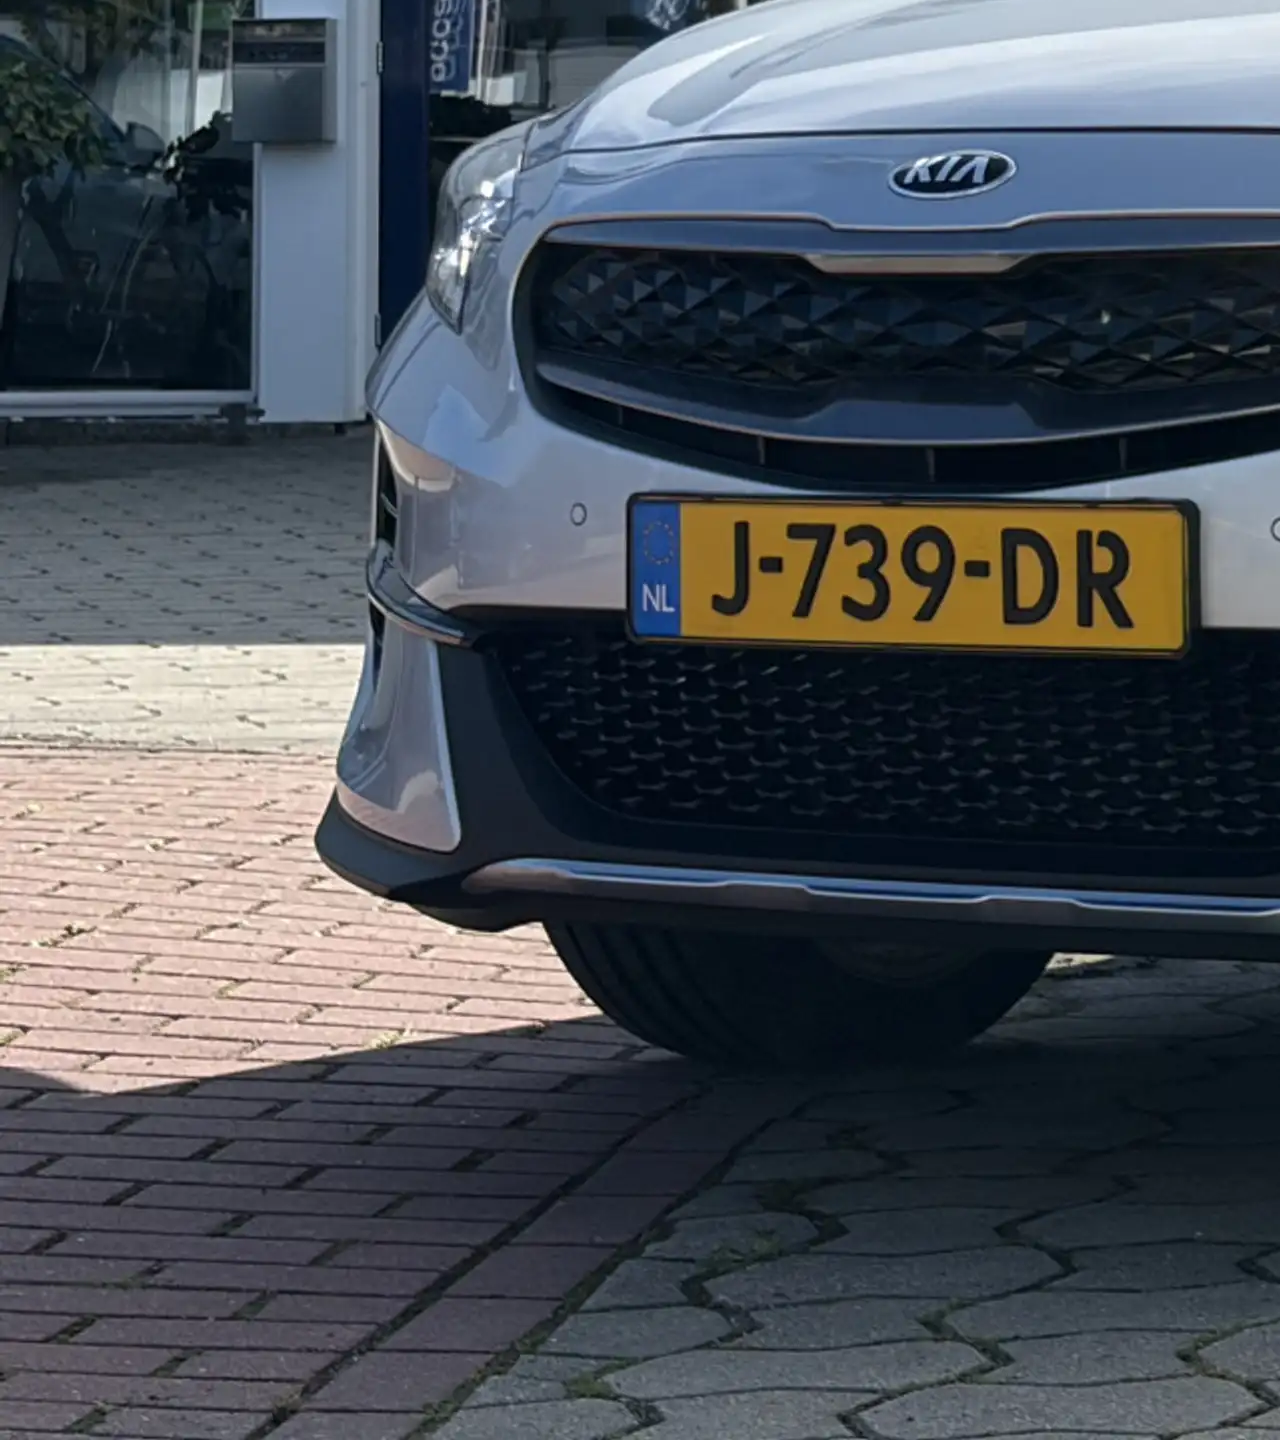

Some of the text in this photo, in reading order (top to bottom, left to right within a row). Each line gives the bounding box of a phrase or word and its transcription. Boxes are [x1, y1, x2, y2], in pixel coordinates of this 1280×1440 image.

[904, 155, 989, 184] KIA
[642, 520, 1135, 630] NL J-739-DR
